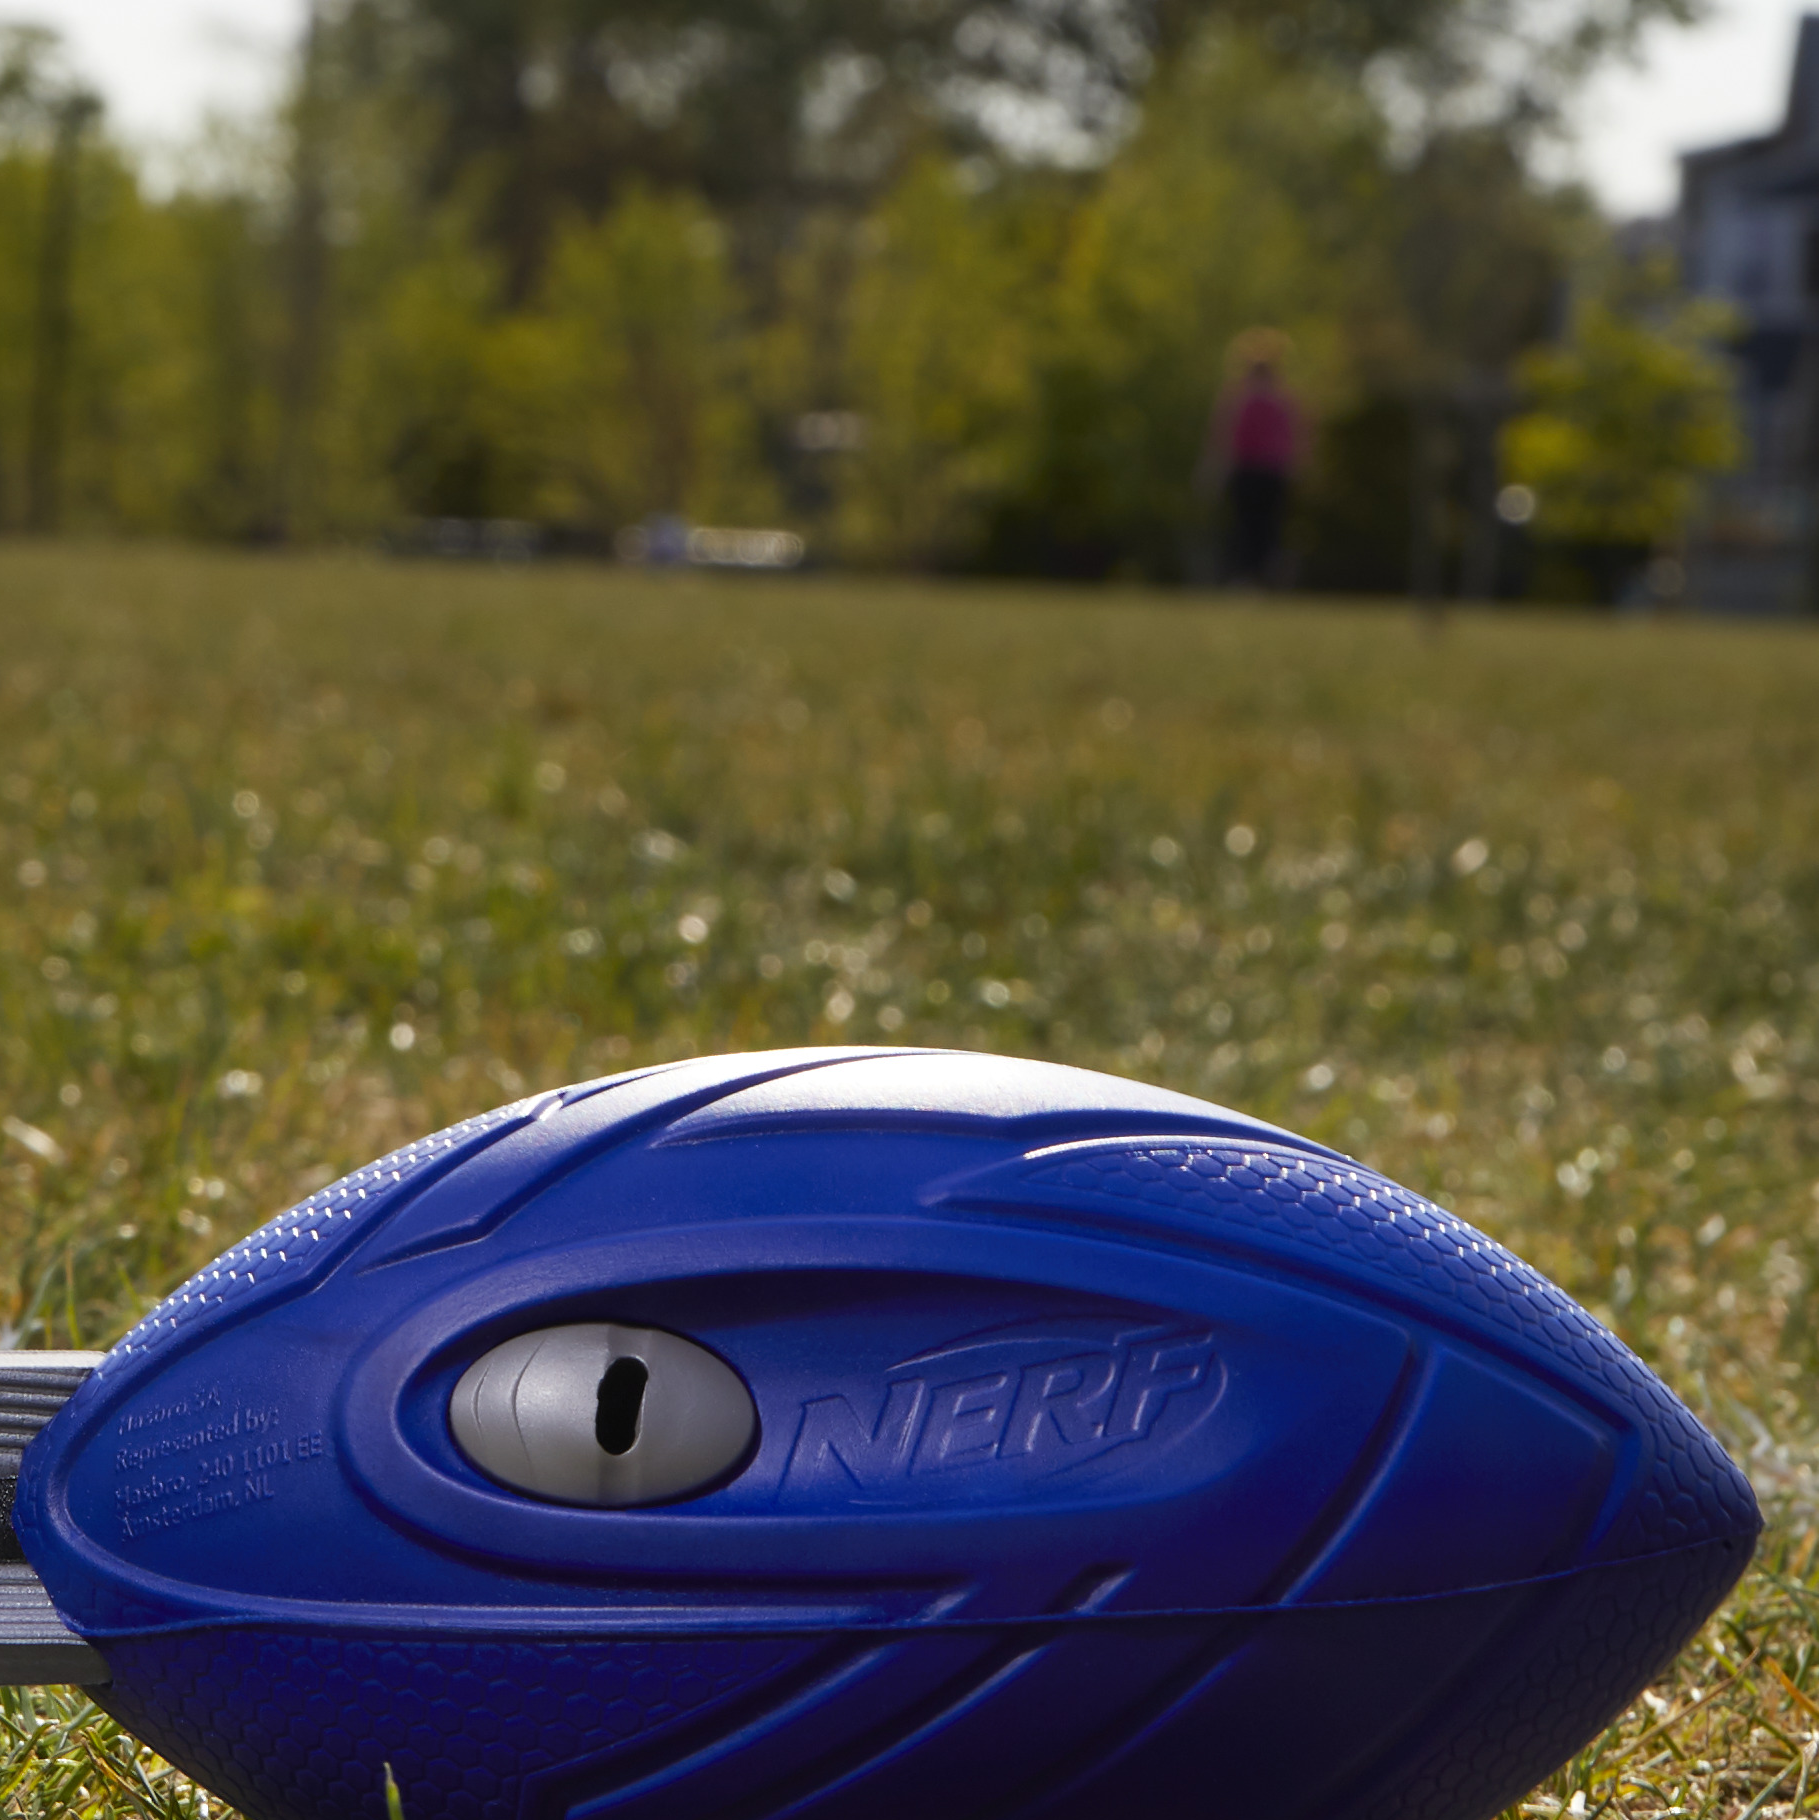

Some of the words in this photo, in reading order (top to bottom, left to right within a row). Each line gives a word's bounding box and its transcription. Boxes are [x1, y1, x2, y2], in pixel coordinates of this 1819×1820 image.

[781, 1325, 1215, 1490] NERF
[114, 1411, 240, 1473] Represented
[242, 1439, 291, 1474] 1101
[297, 1429, 323, 1458] EE
[244, 1474, 275, 1501] NL
